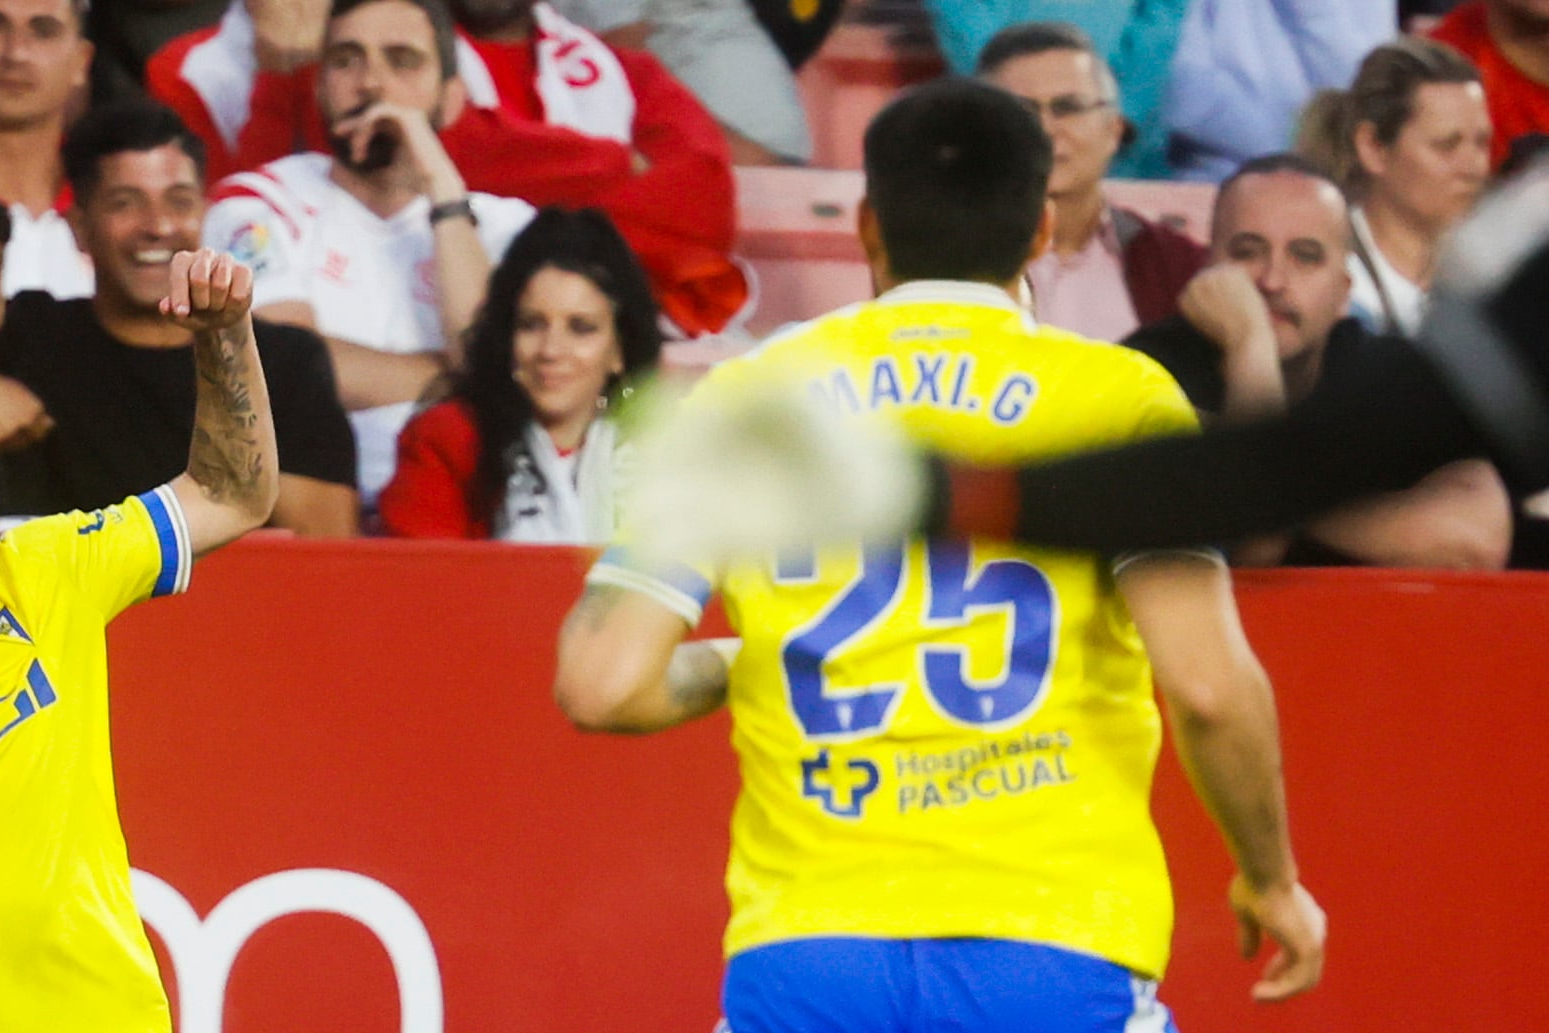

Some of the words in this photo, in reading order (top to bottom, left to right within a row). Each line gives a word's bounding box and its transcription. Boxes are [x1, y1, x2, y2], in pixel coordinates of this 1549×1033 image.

[773, 538, 1062, 742] 25
[895, 729, 1072, 780] Hospitales
[899, 754, 1077, 814] PASCUAL
